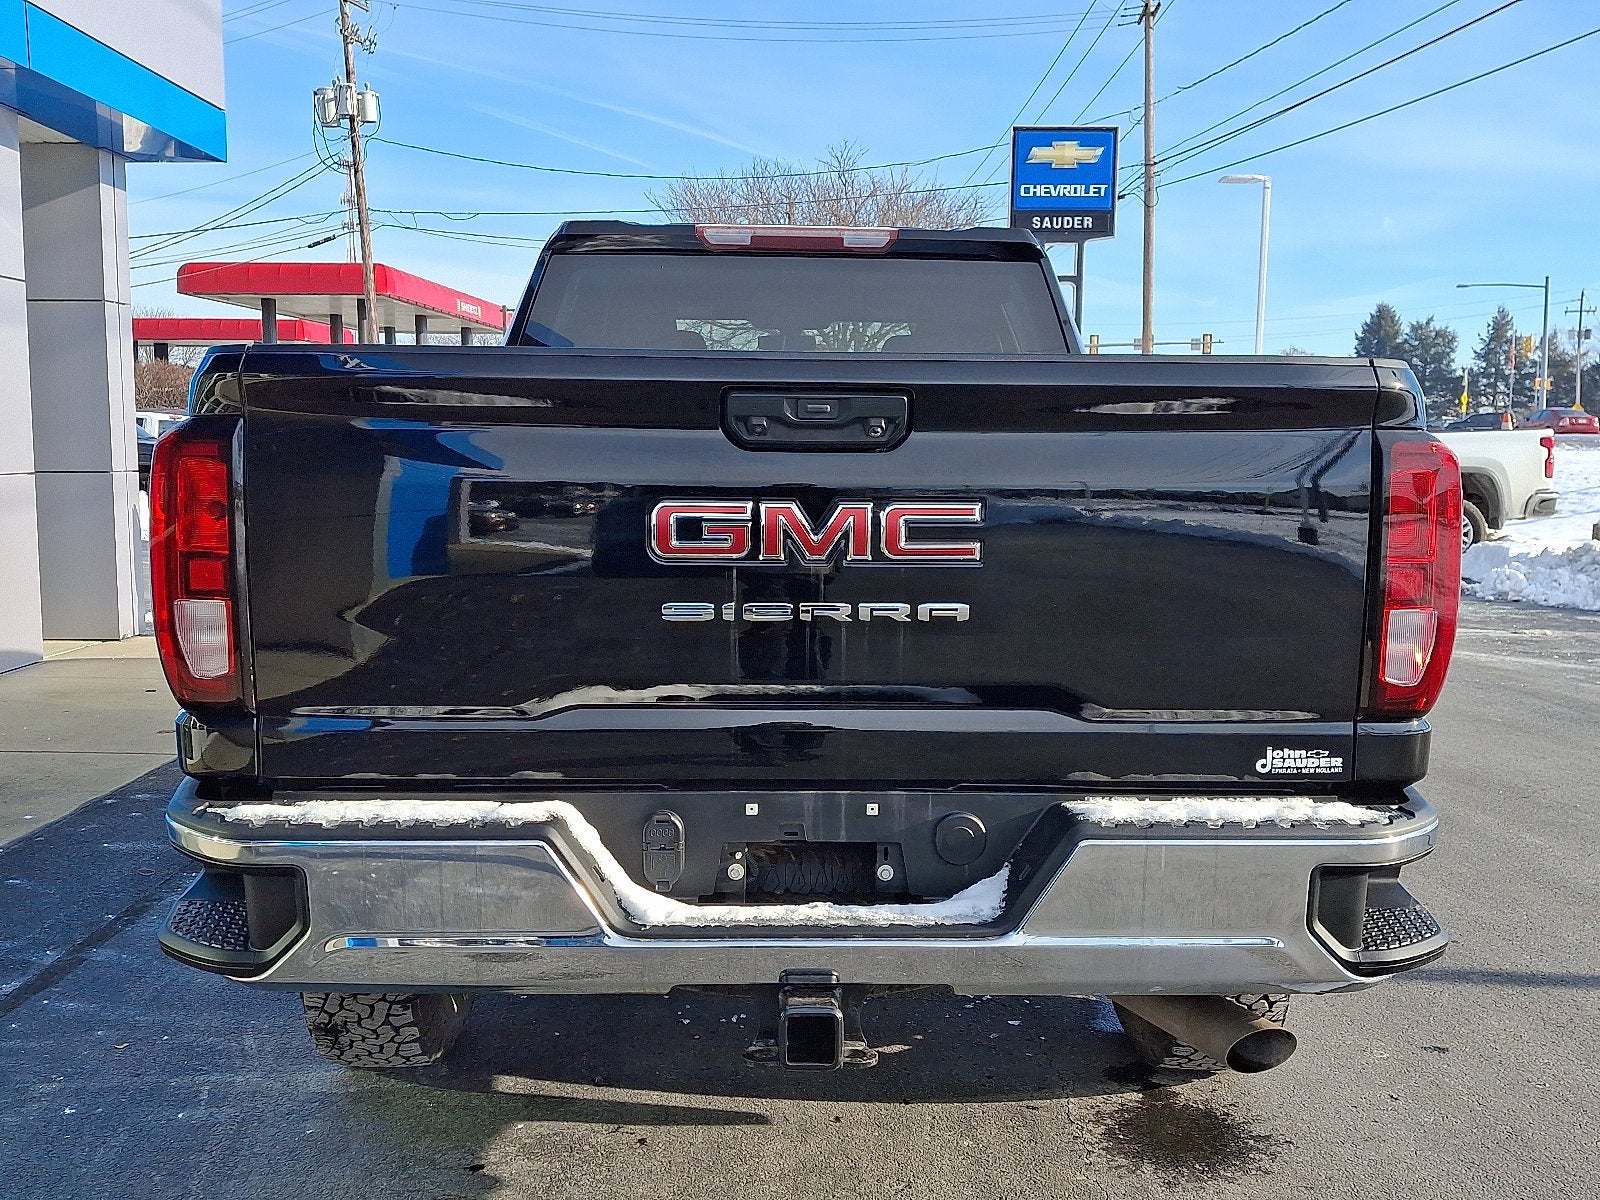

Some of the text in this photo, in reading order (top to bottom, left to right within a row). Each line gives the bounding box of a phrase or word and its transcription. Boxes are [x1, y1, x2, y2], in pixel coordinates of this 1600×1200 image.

[1020, 184, 1109, 197] CHEVROLET
[1032, 216, 1093, 229] SAUDER
[648, 498, 985, 566] GMC
[661, 601, 971, 622] SIERRA
[1271, 757, 1344, 767] SAUDER
